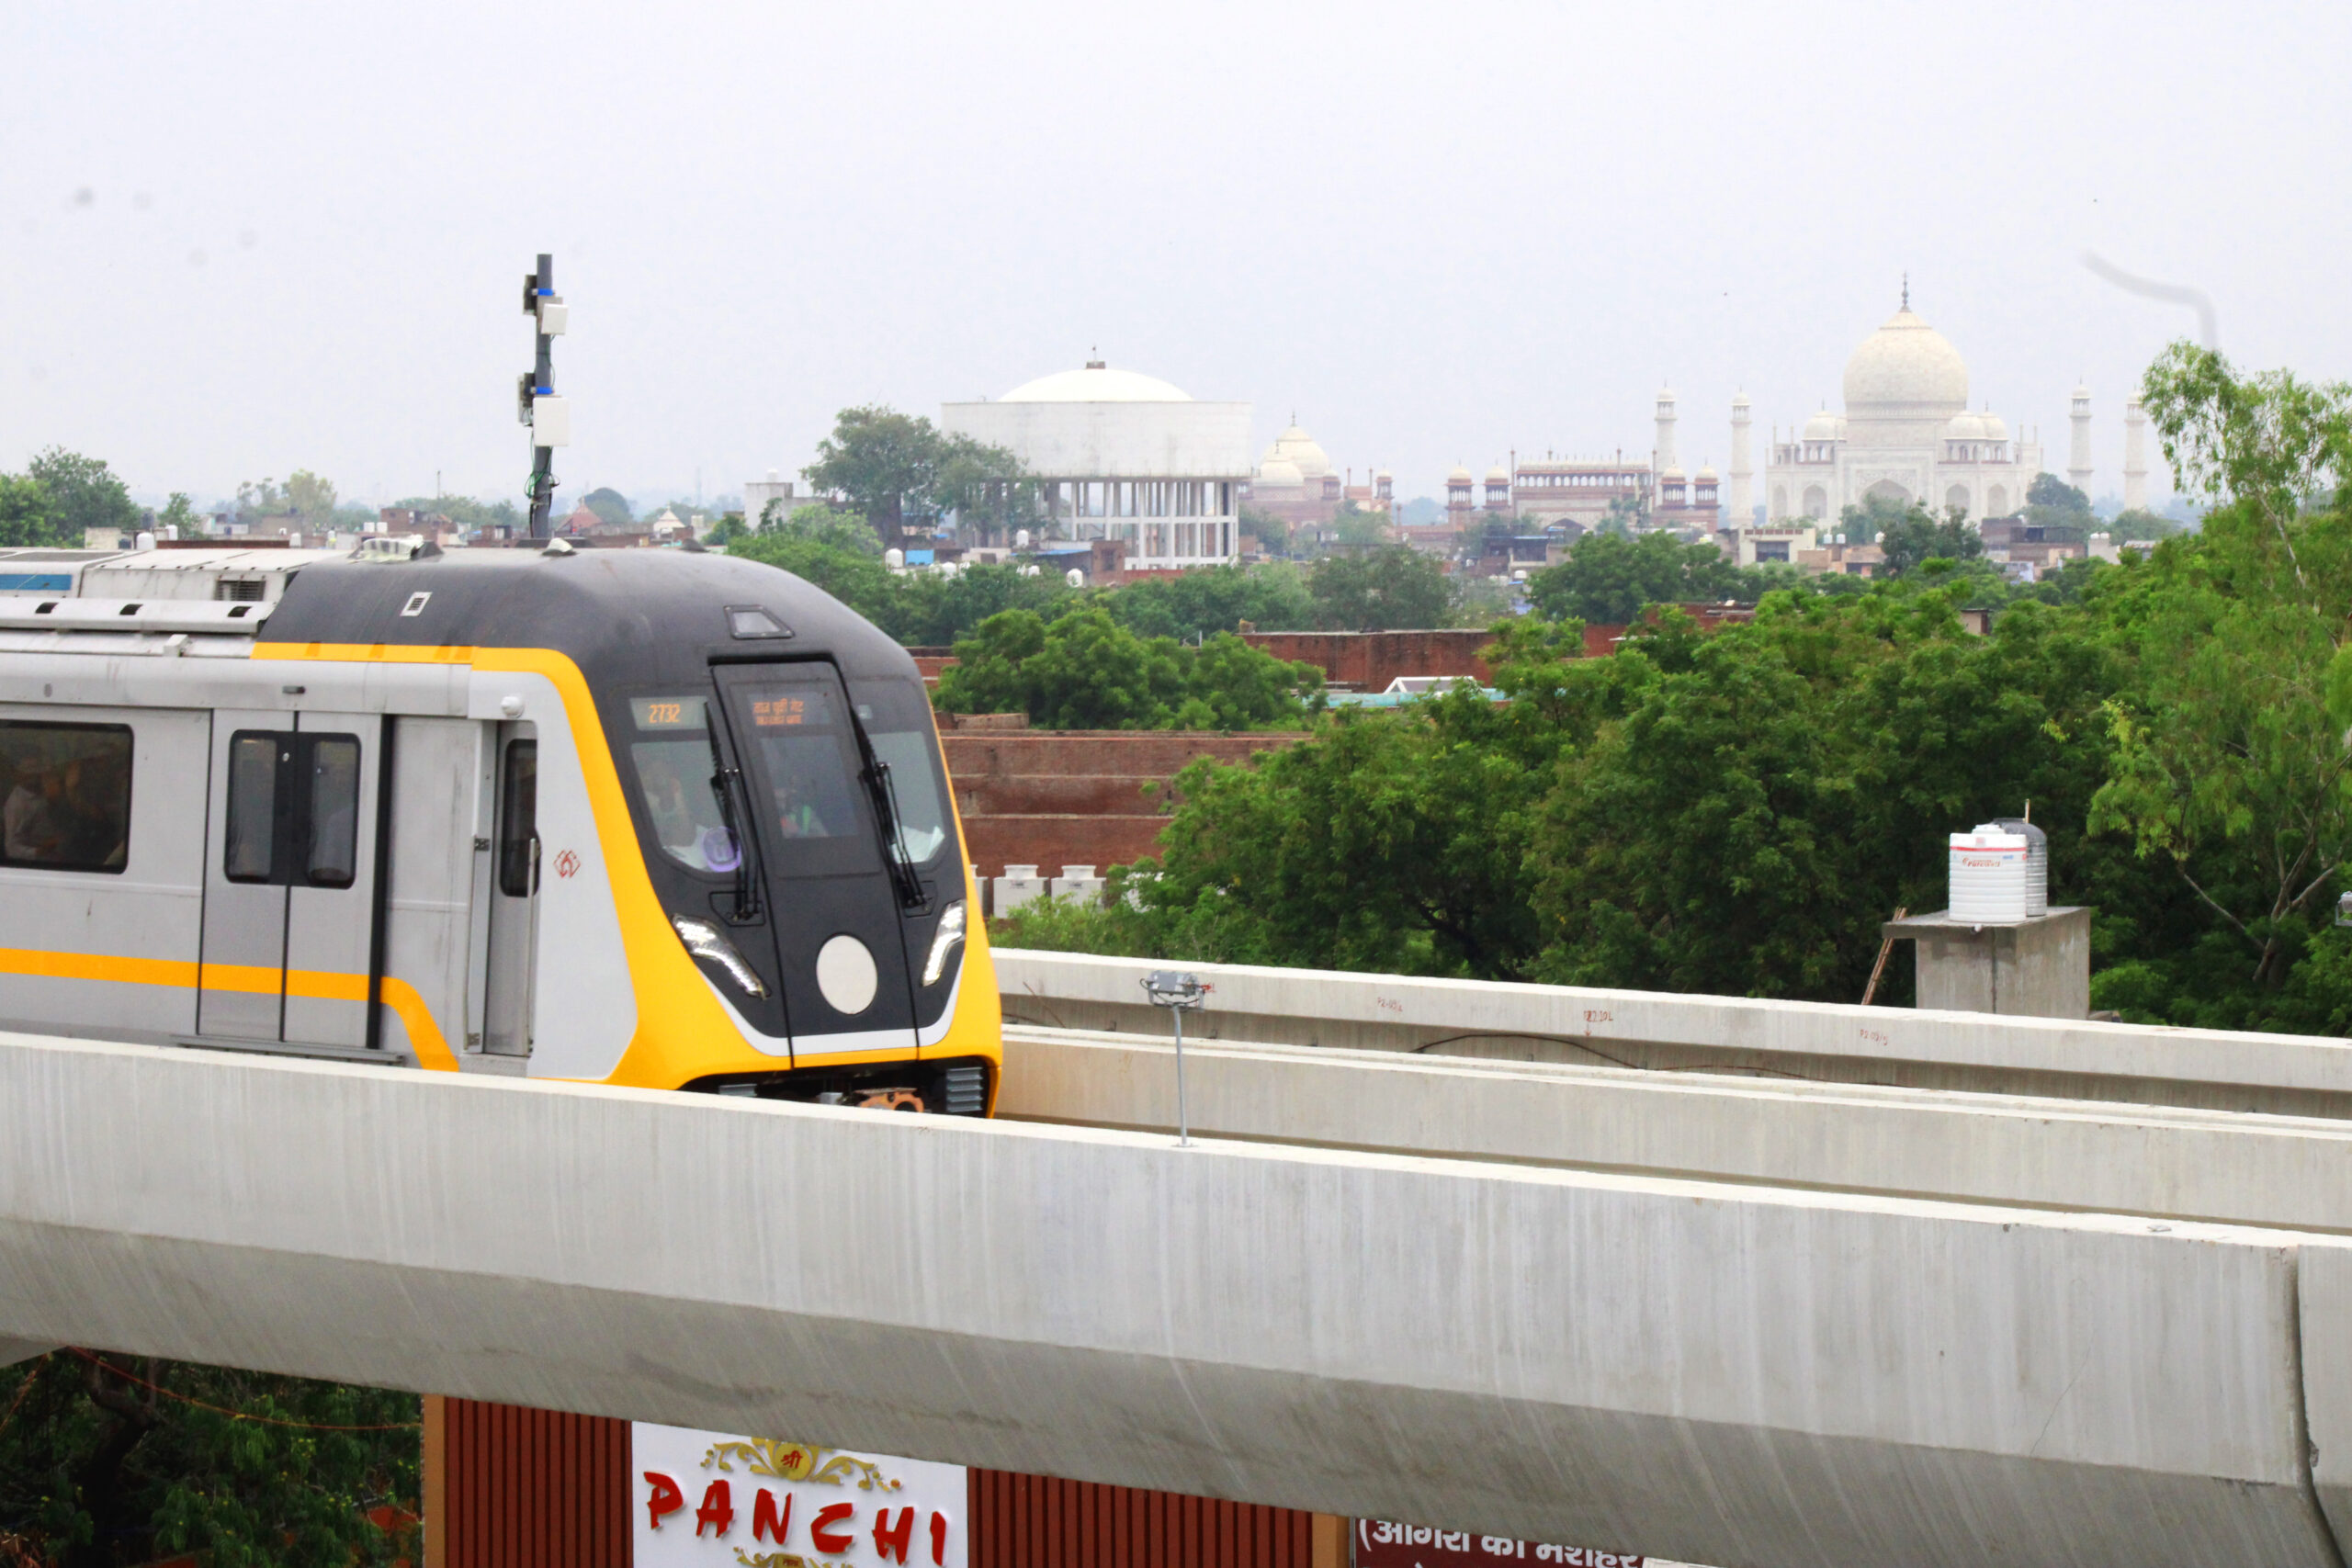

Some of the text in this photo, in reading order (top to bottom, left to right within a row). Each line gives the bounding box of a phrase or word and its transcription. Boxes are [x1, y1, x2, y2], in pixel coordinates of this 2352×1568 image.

[649, 704, 681, 724] 2732
[781, 1450, 803, 1470] श्री
[643, 1471, 947, 1567] PANCHI
